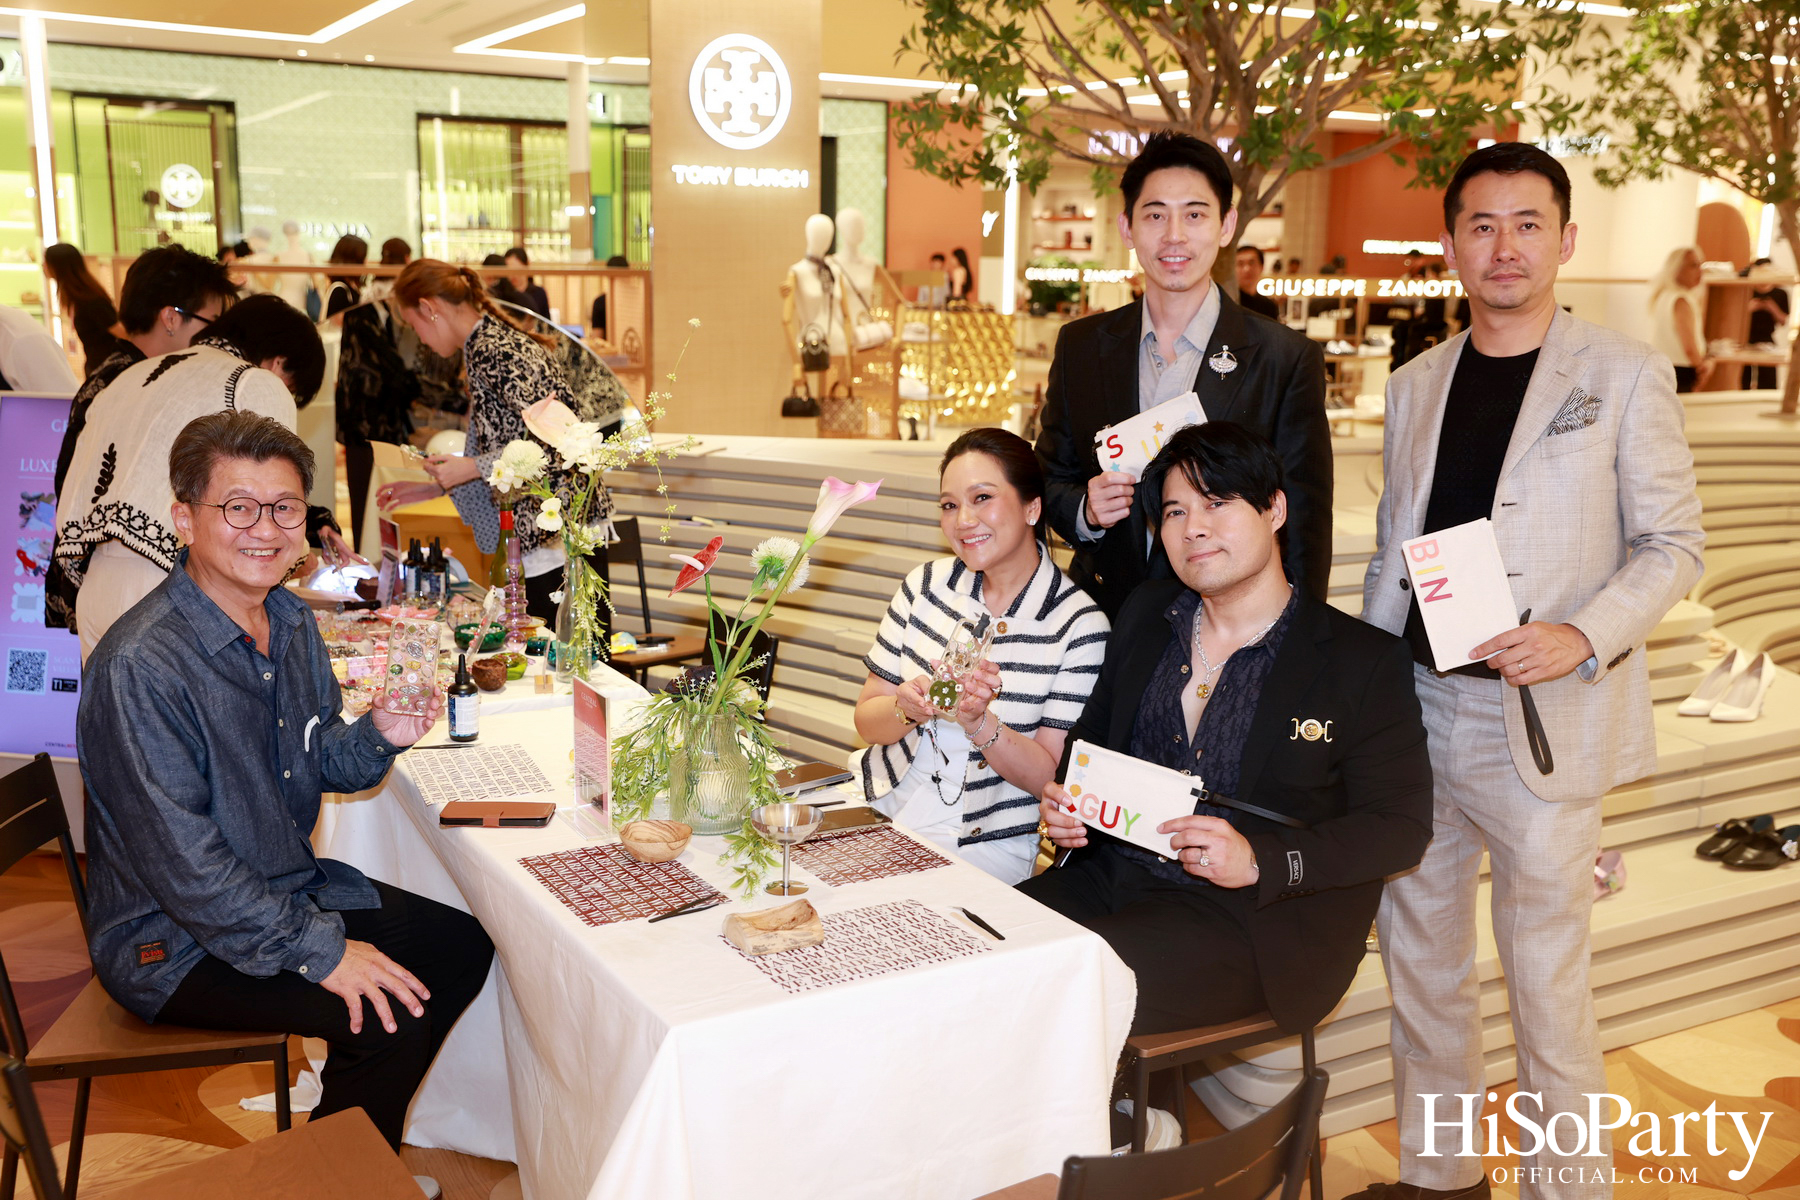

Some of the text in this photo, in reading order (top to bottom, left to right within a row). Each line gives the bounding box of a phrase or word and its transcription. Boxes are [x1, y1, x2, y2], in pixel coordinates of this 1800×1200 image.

[671, 164, 809, 188] TORY BURCH
[1257, 278, 1367, 296] GIUSEPPE
[1408, 538, 1453, 603] BIN
[1079, 793, 1141, 836] GUY
